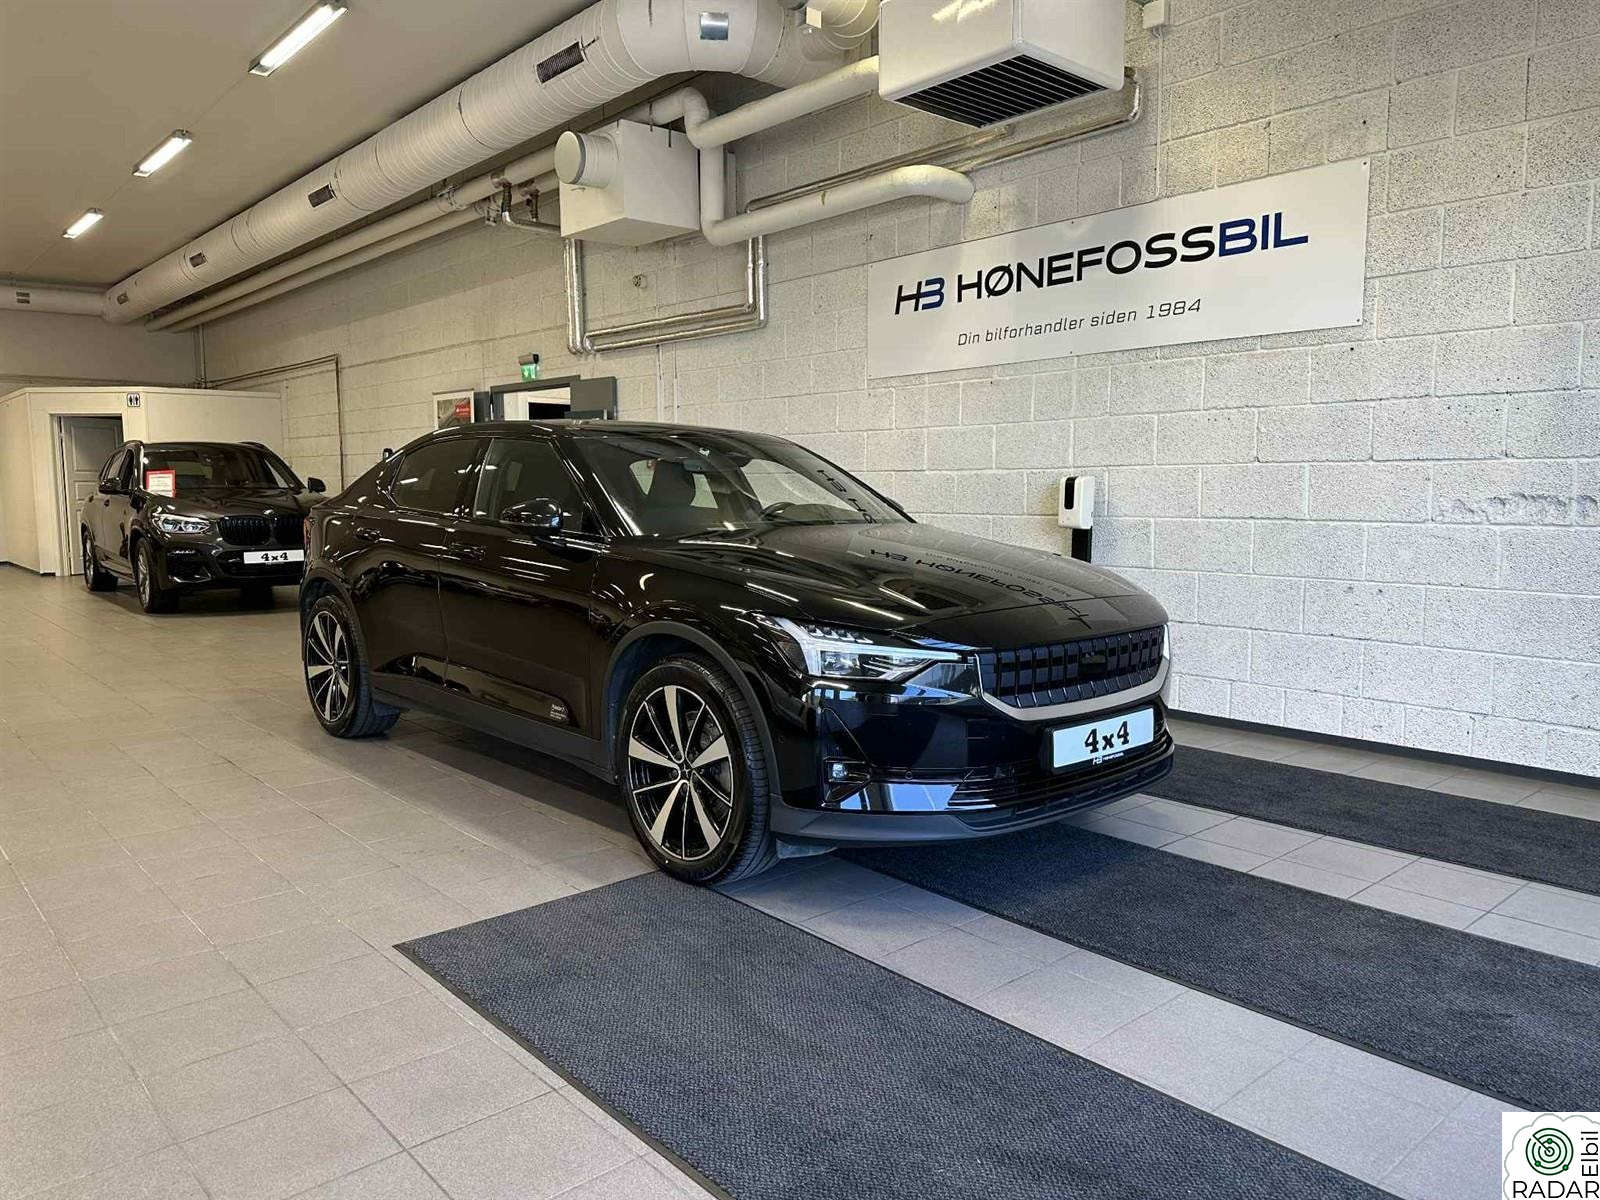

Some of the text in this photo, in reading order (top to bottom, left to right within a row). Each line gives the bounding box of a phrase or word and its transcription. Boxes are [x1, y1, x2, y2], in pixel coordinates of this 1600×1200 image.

[895, 211, 1308, 314] HB HØNEFOSSBIL
[958, 298, 1201, 346] Din bilforhandler siden 1984
[261, 552, 288, 561] 4x4
[1084, 720, 1130, 753] 4x4
